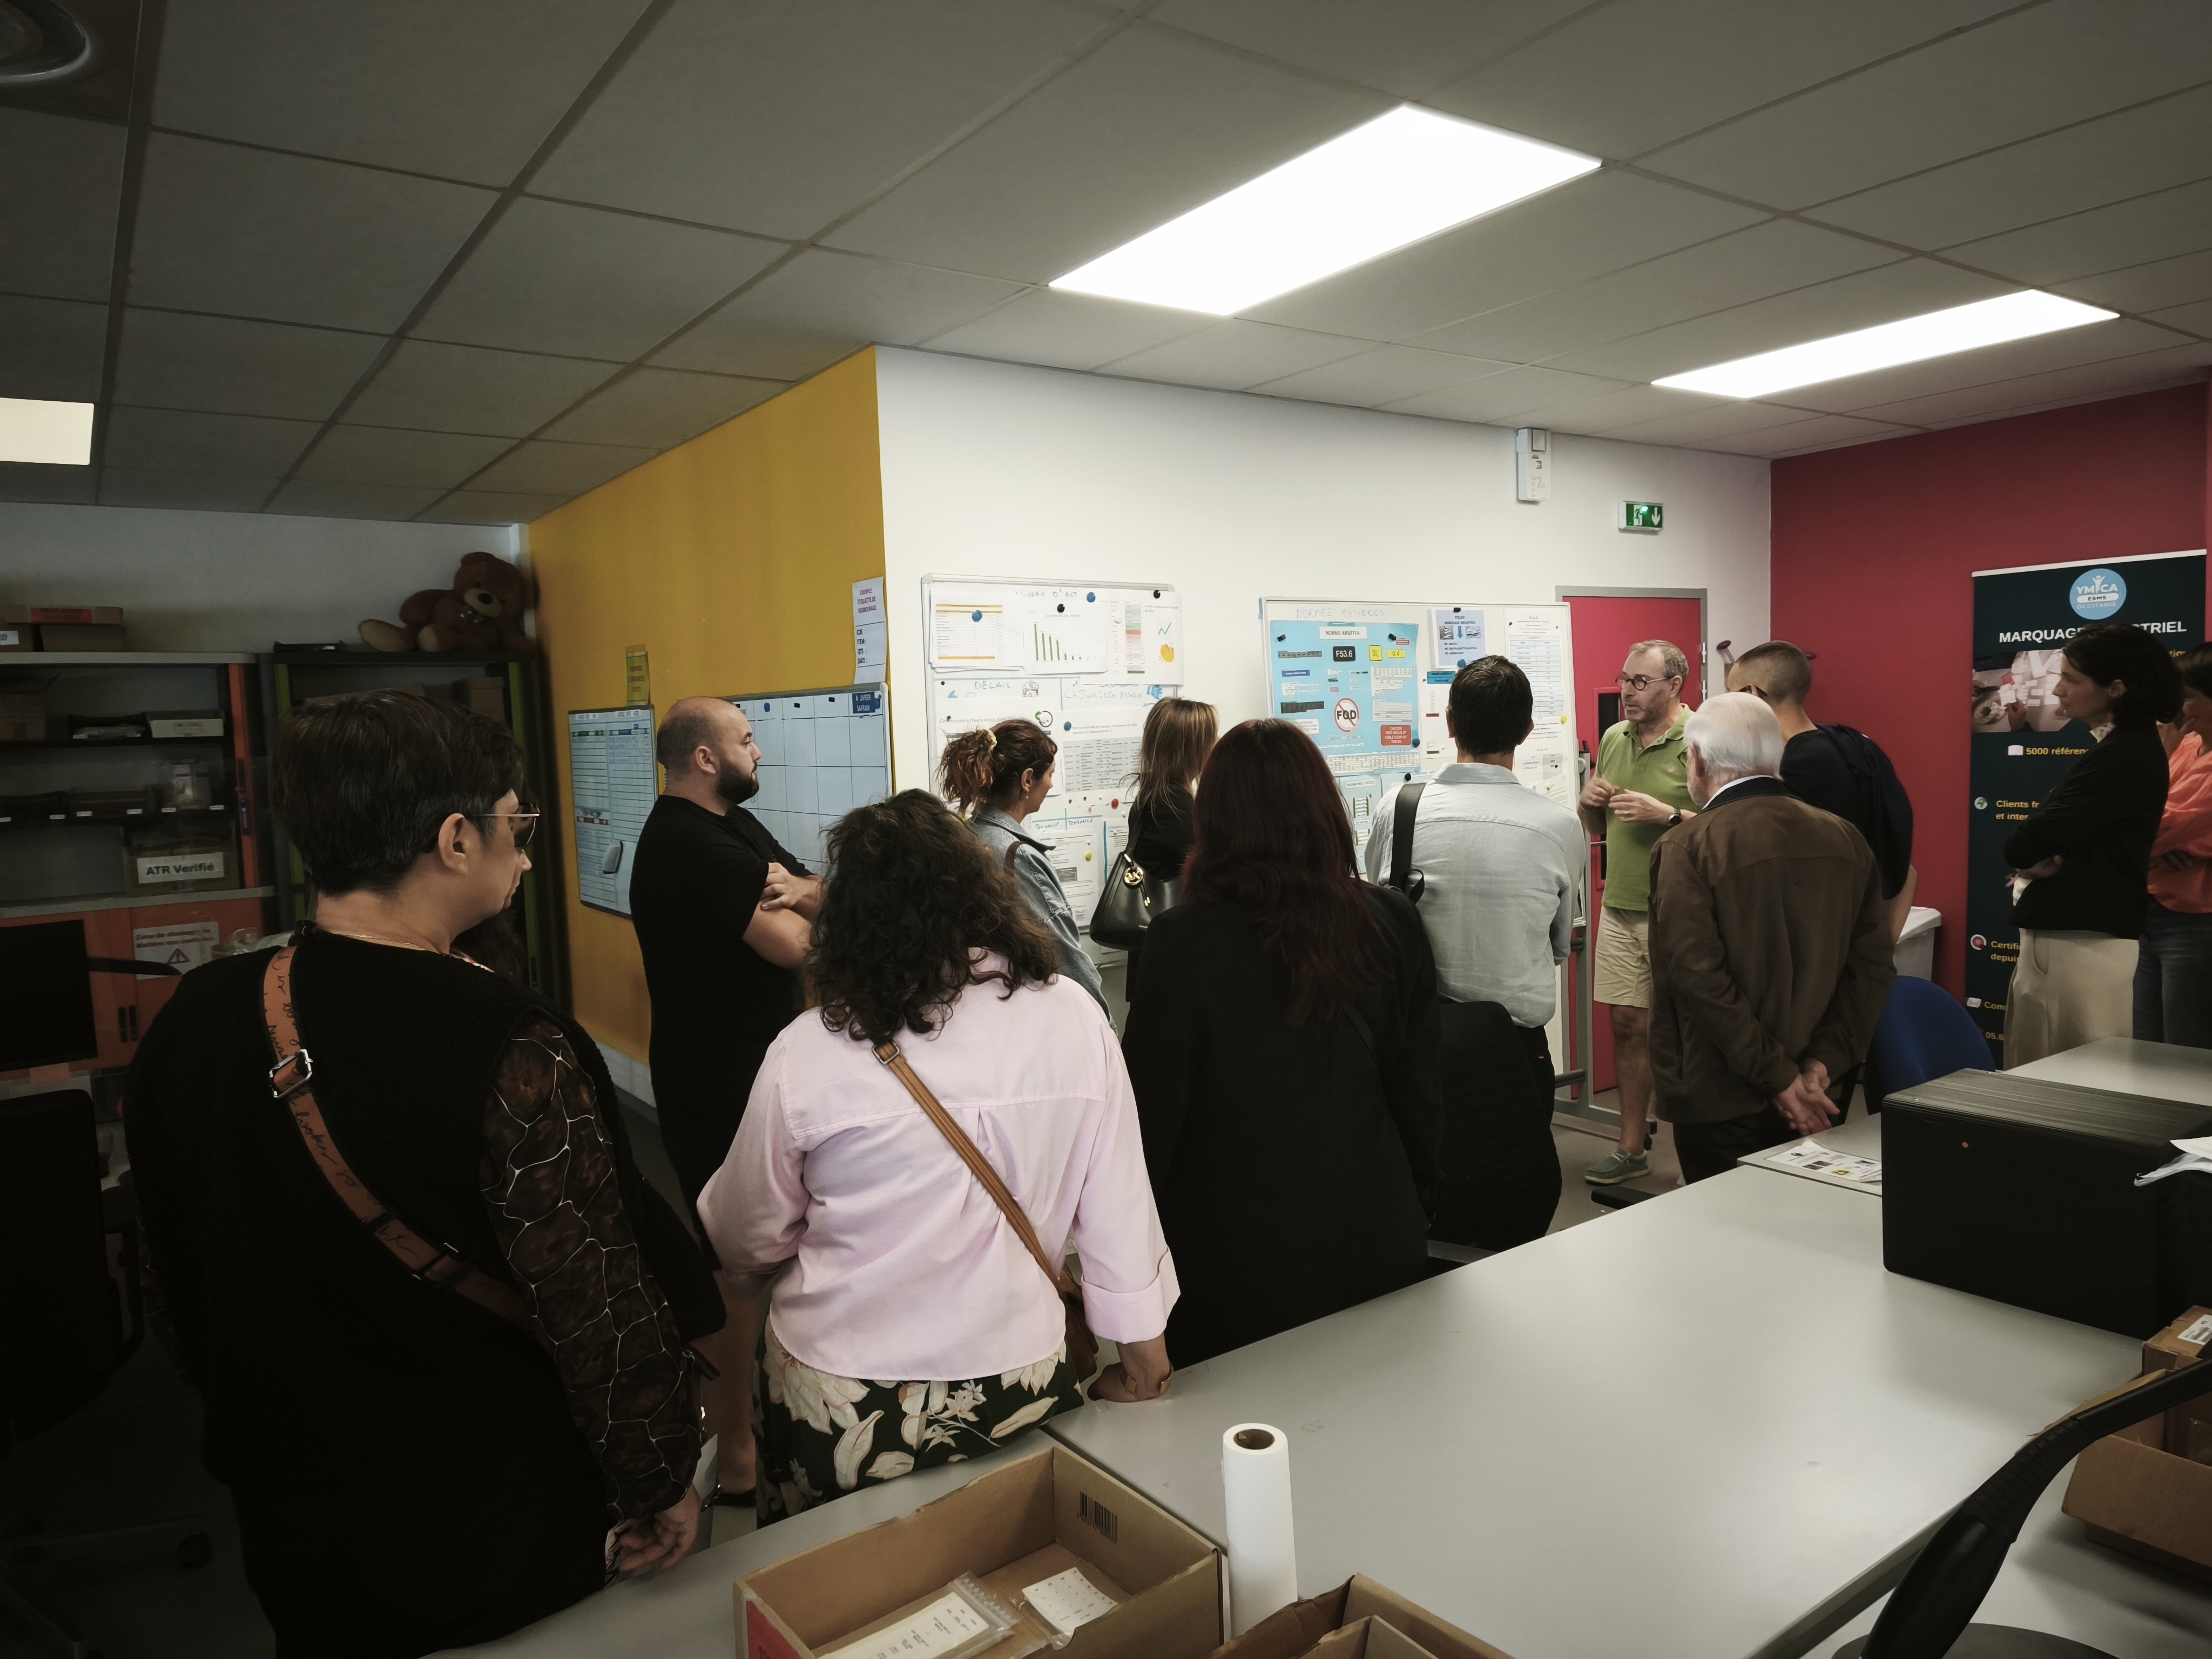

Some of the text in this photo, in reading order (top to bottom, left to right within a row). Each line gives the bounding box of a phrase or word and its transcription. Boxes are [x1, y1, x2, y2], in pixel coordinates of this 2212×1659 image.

[2076, 602, 2117, 610] OCCITANIE
[1296, 608, 1333, 619] NORMES
[1336, 650, 1353, 658] F53.6
[1078, 690, 1097, 699] Juin
[1098, 690, 1116, 699] 2026
[1337, 710, 1357, 720] FOD
[1995, 800, 2029, 808] Clients
[2007, 812, 2029, 820] inter
[146, 865, 171, 875] ATR
[1984, 1001, 2006, 1011] Com
[1985, 1031, 2005, 1041] 05.6
